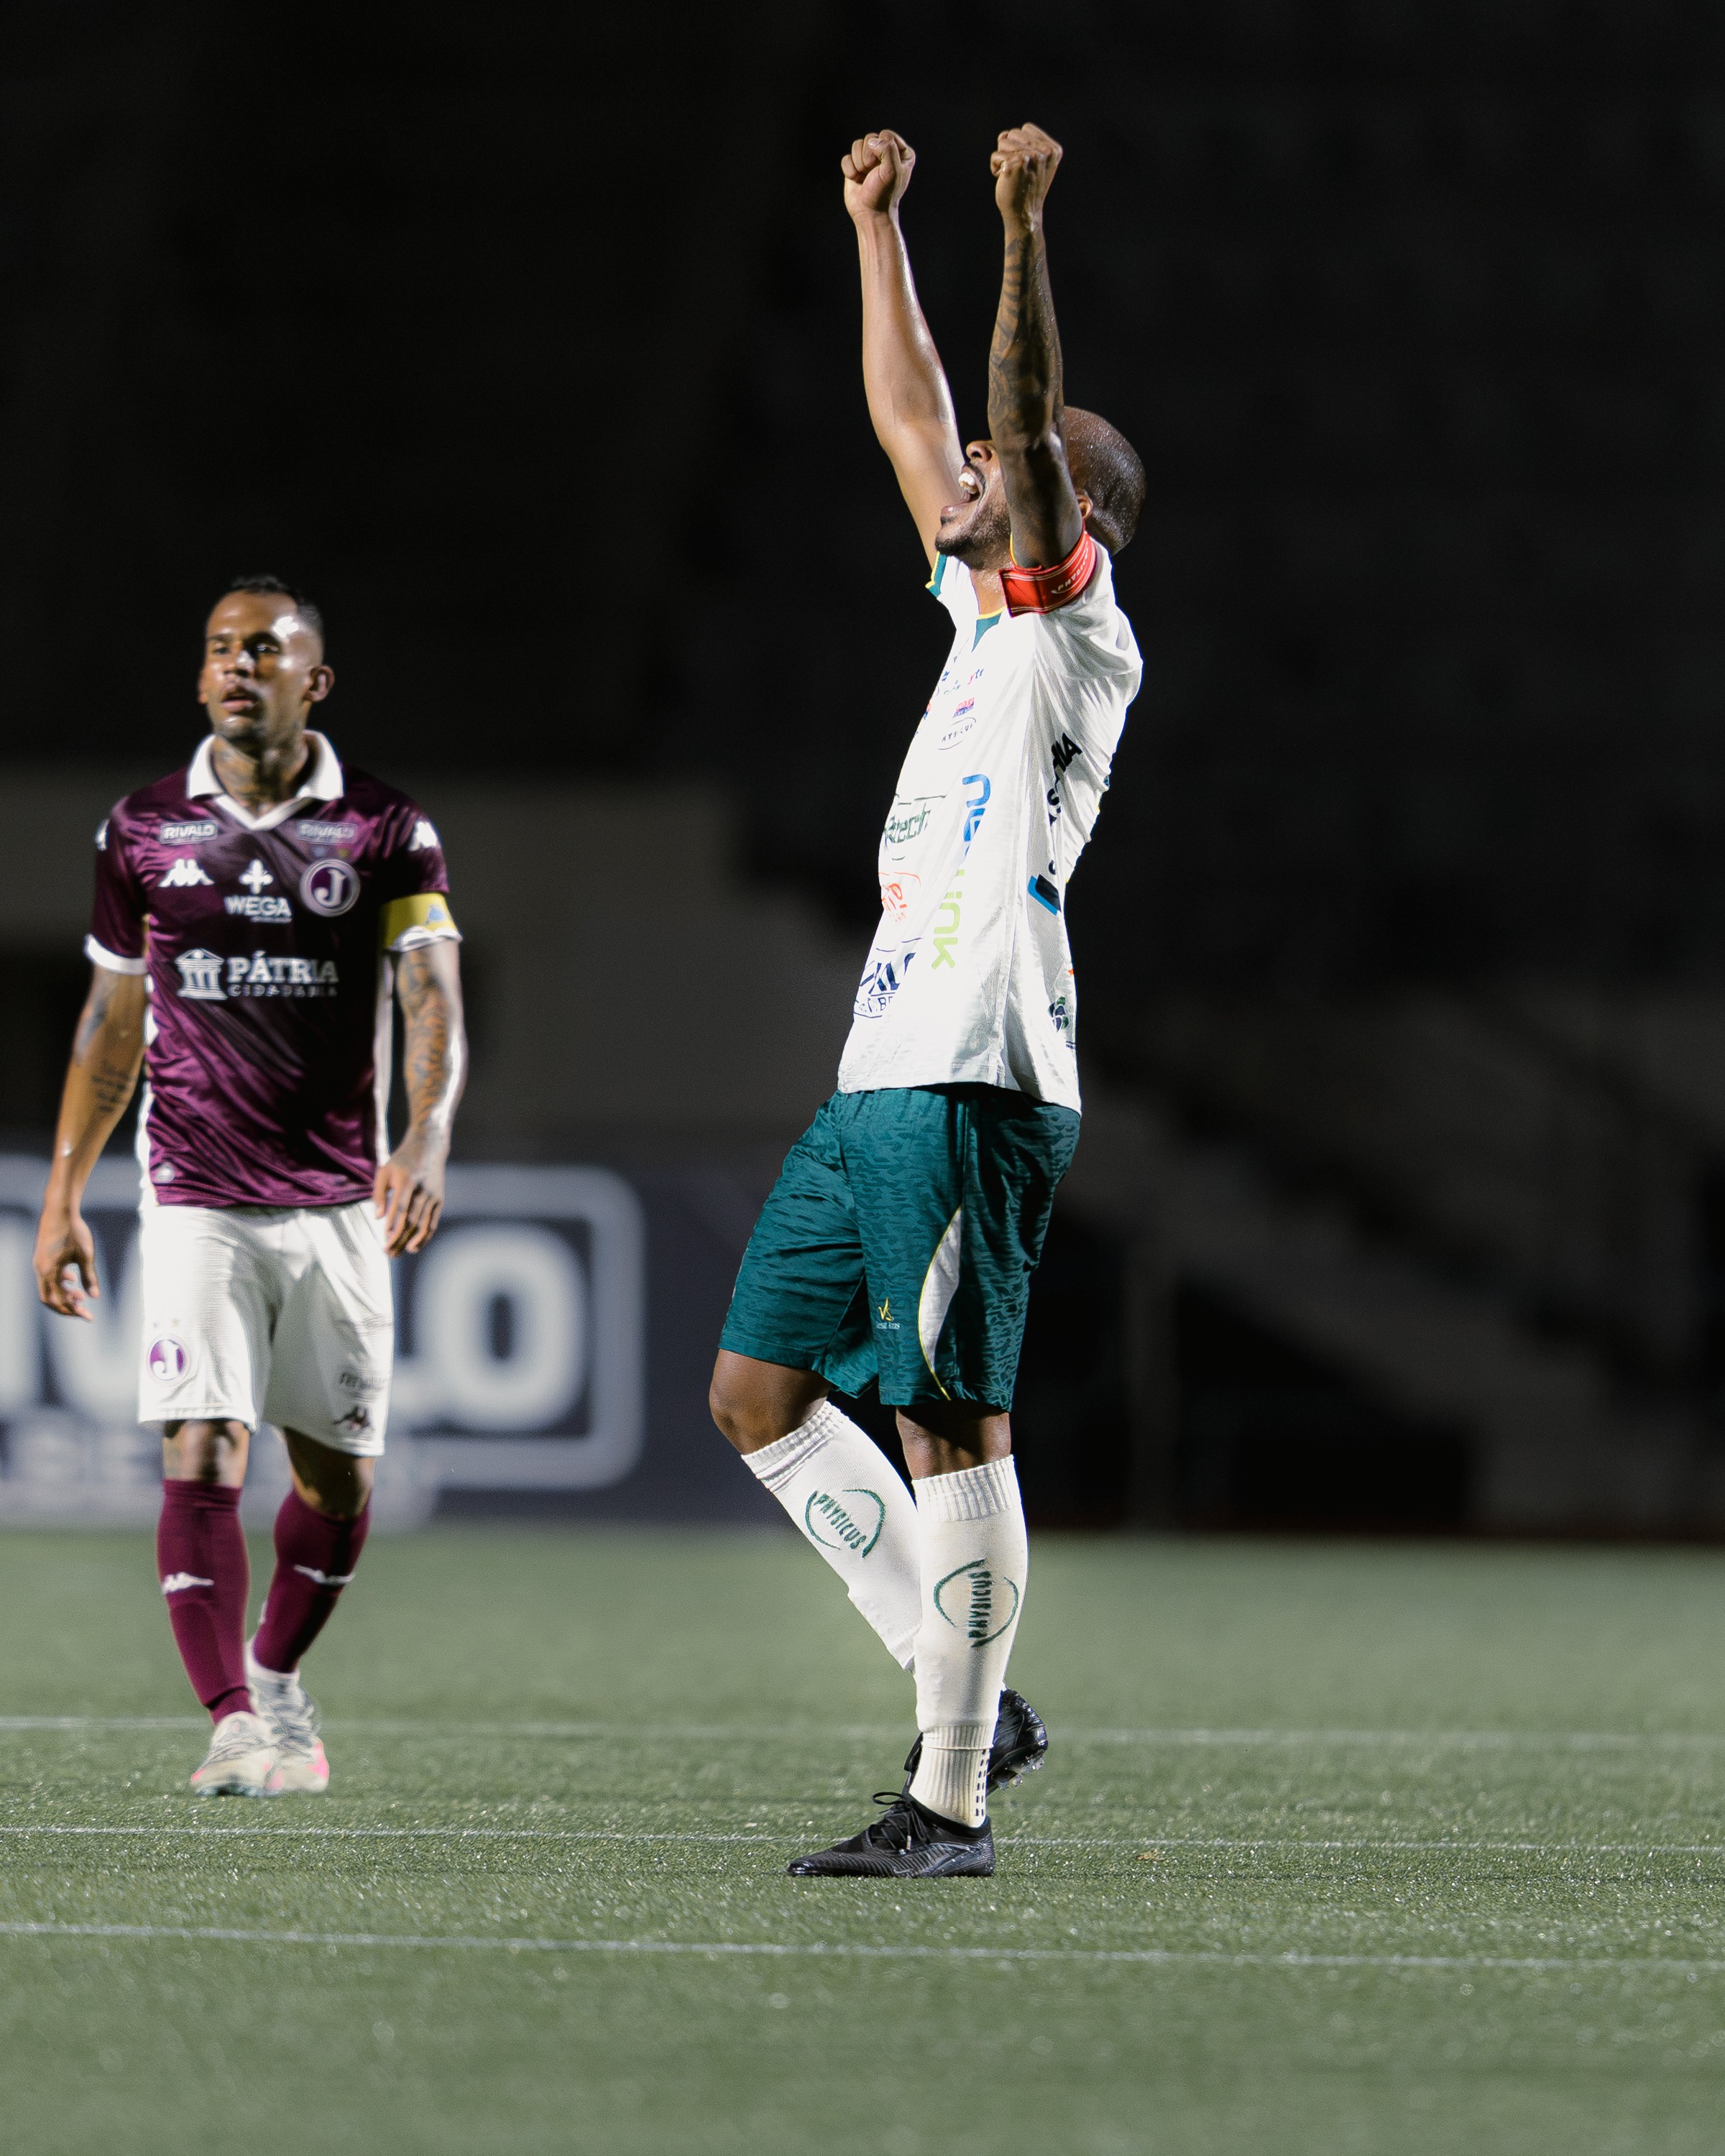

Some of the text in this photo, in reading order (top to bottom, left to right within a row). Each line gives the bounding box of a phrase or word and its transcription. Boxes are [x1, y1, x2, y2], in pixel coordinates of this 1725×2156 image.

[224, 895, 292, 917] WEGA
[312, 869, 346, 908] J
[226, 950, 339, 983] PÁTRIA
[813, 1493, 868, 1550] PHYSICUS
[967, 1570, 993, 1639] PHYSICUS
